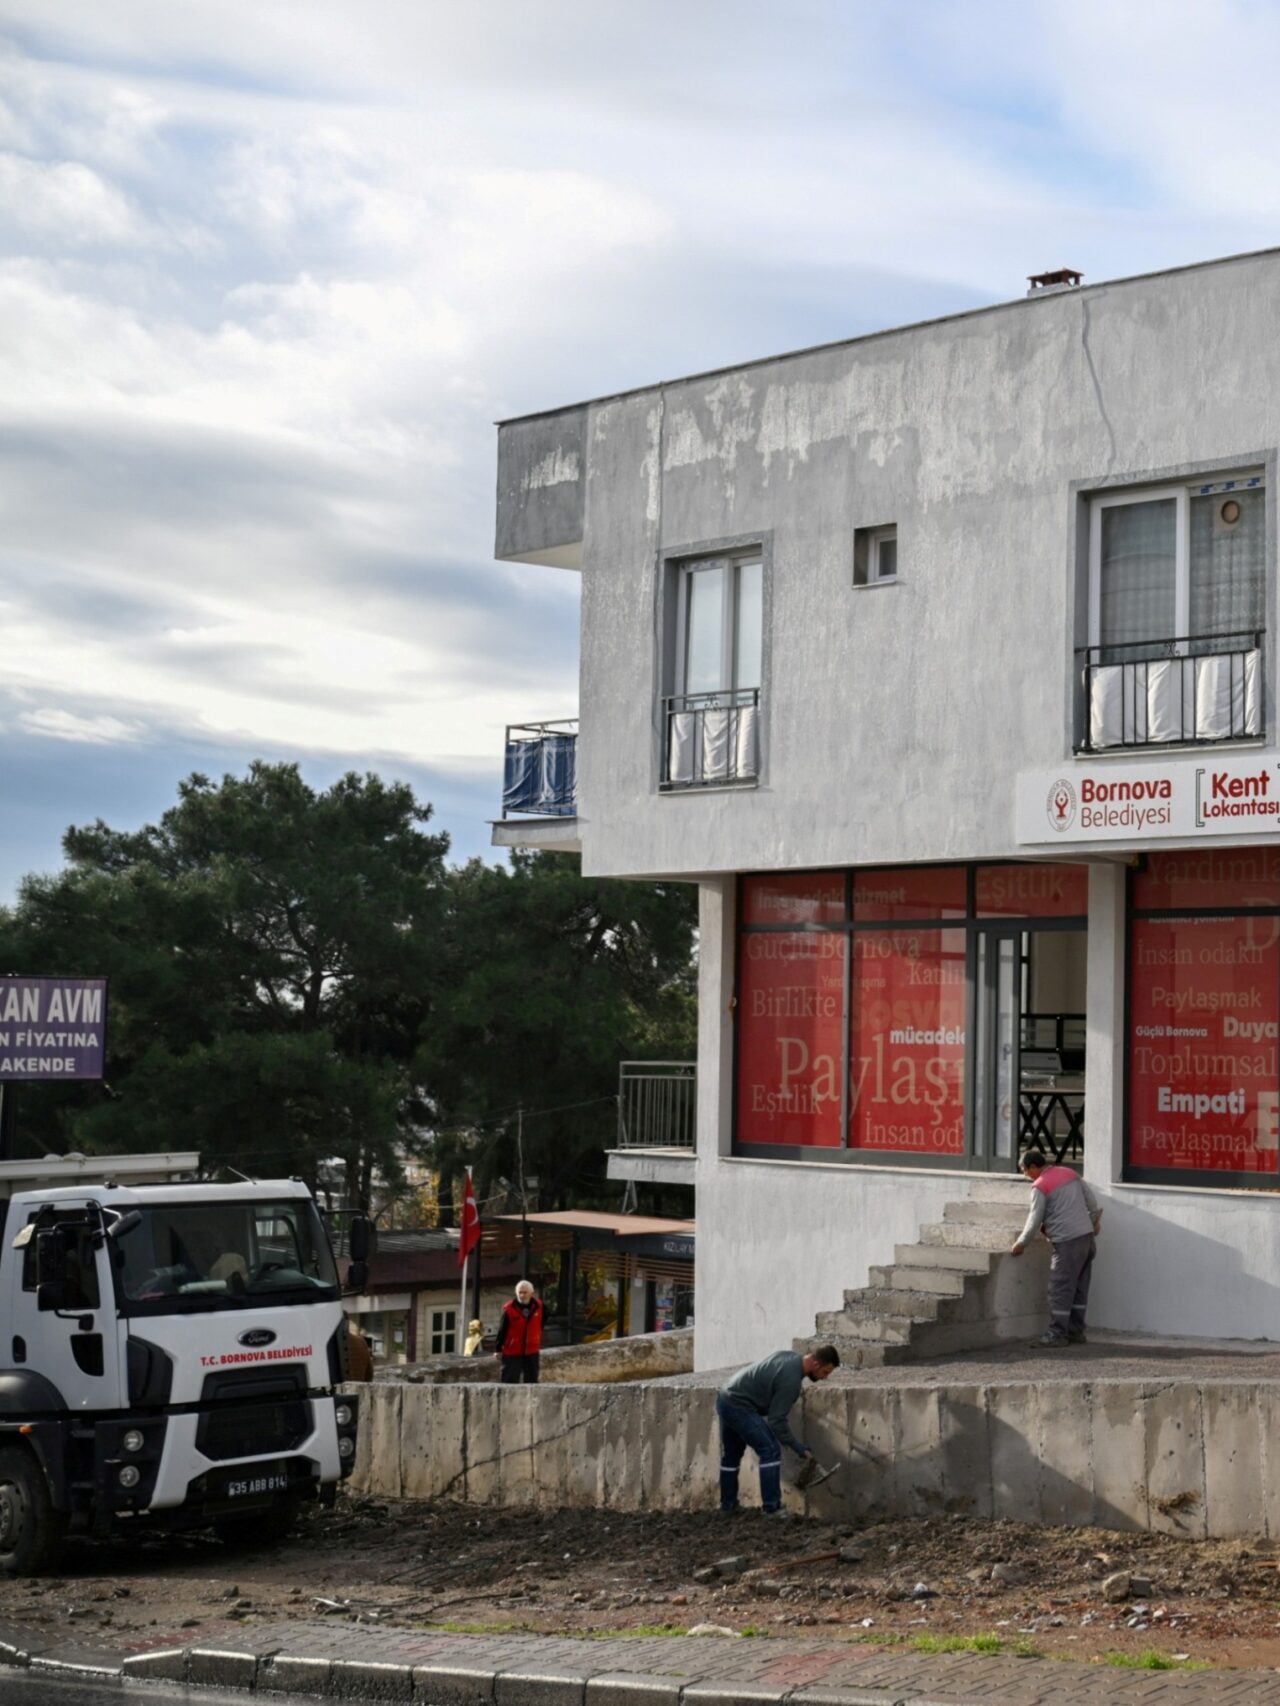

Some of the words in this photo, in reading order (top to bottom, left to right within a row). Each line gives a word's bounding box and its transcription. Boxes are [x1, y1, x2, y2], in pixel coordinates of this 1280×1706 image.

[1081, 779, 1172, 803] Bornova
[1211, 769, 1270, 799] Kent
[1081, 802, 1171, 830] Belediyesi
[1203, 800, 1280, 818] Lokantası
[46, 987, 102, 1024] AVM
[751, 988, 836, 1019] Birlikte
[1151, 985, 1263, 1015] Paylaşmak
[15, 1028, 100, 1048] FİYATINA
[1166, 1026, 1208, 1039] Bornova
[0, 1056, 76, 1073] AKENDE
[1134, 1044, 1279, 1087] Toplumsal
[778, 1032, 966, 1127] Paylaş
[1157, 1086, 1245, 1120] Empati
[864, 1112, 925, 1146] İnsan
[932, 1121, 966, 1150] od
[201, 1356, 219, 1367] T.C.
[220, 1351, 266, 1364] BORNOVA
[267, 1345, 312, 1360] BELEDİYESİ
[235, 1481, 247, 1494] 35
